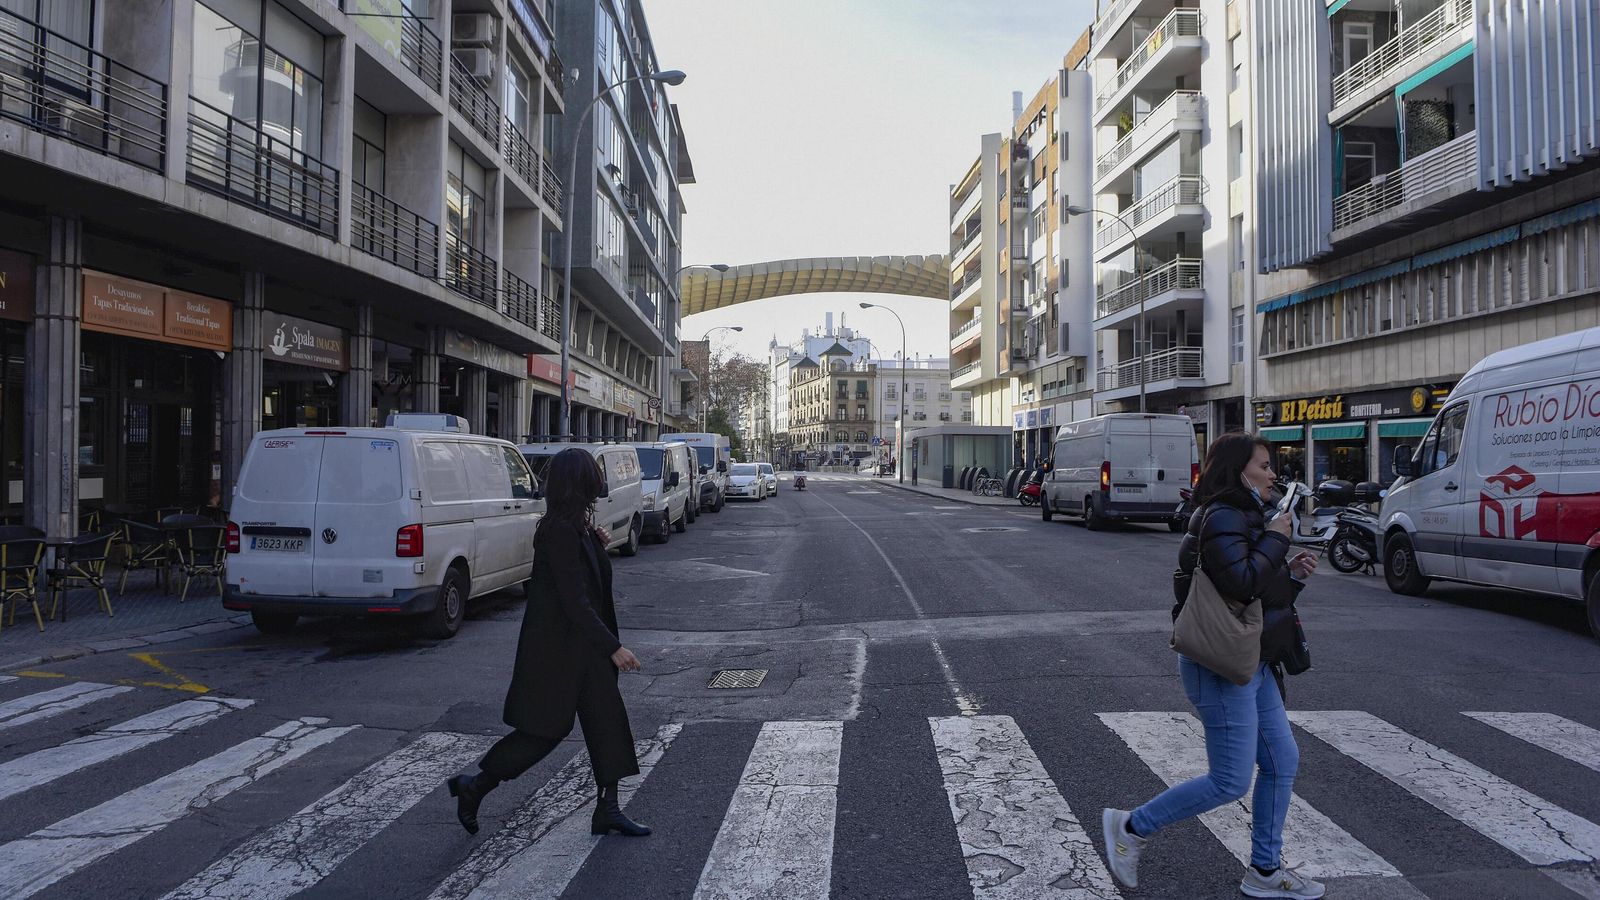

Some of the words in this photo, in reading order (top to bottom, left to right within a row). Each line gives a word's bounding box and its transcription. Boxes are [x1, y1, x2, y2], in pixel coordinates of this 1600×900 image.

[107, 283, 142, 300] Desayunos
[92, 295, 113, 310] Tapas
[112, 299, 155, 317] Tradicionales
[186, 301, 211, 314] Breakfast
[175, 312, 205, 327] Traditional
[205, 319, 221, 330] Tapas
[292, 326, 315, 350] Spala
[316, 336, 341, 353] IMAGEN
[1280, 401, 1295, 423] El
[1297, 395, 1343, 422] Petisú
[1494, 389, 1559, 429] Rubio
[1491, 432, 1532, 446] Soluciones
[1534, 430, 1557, 444] para
[1559, 427, 1569, 440] la
[257, 538, 281, 549] 3623
[284, 539, 303, 550] KKP
